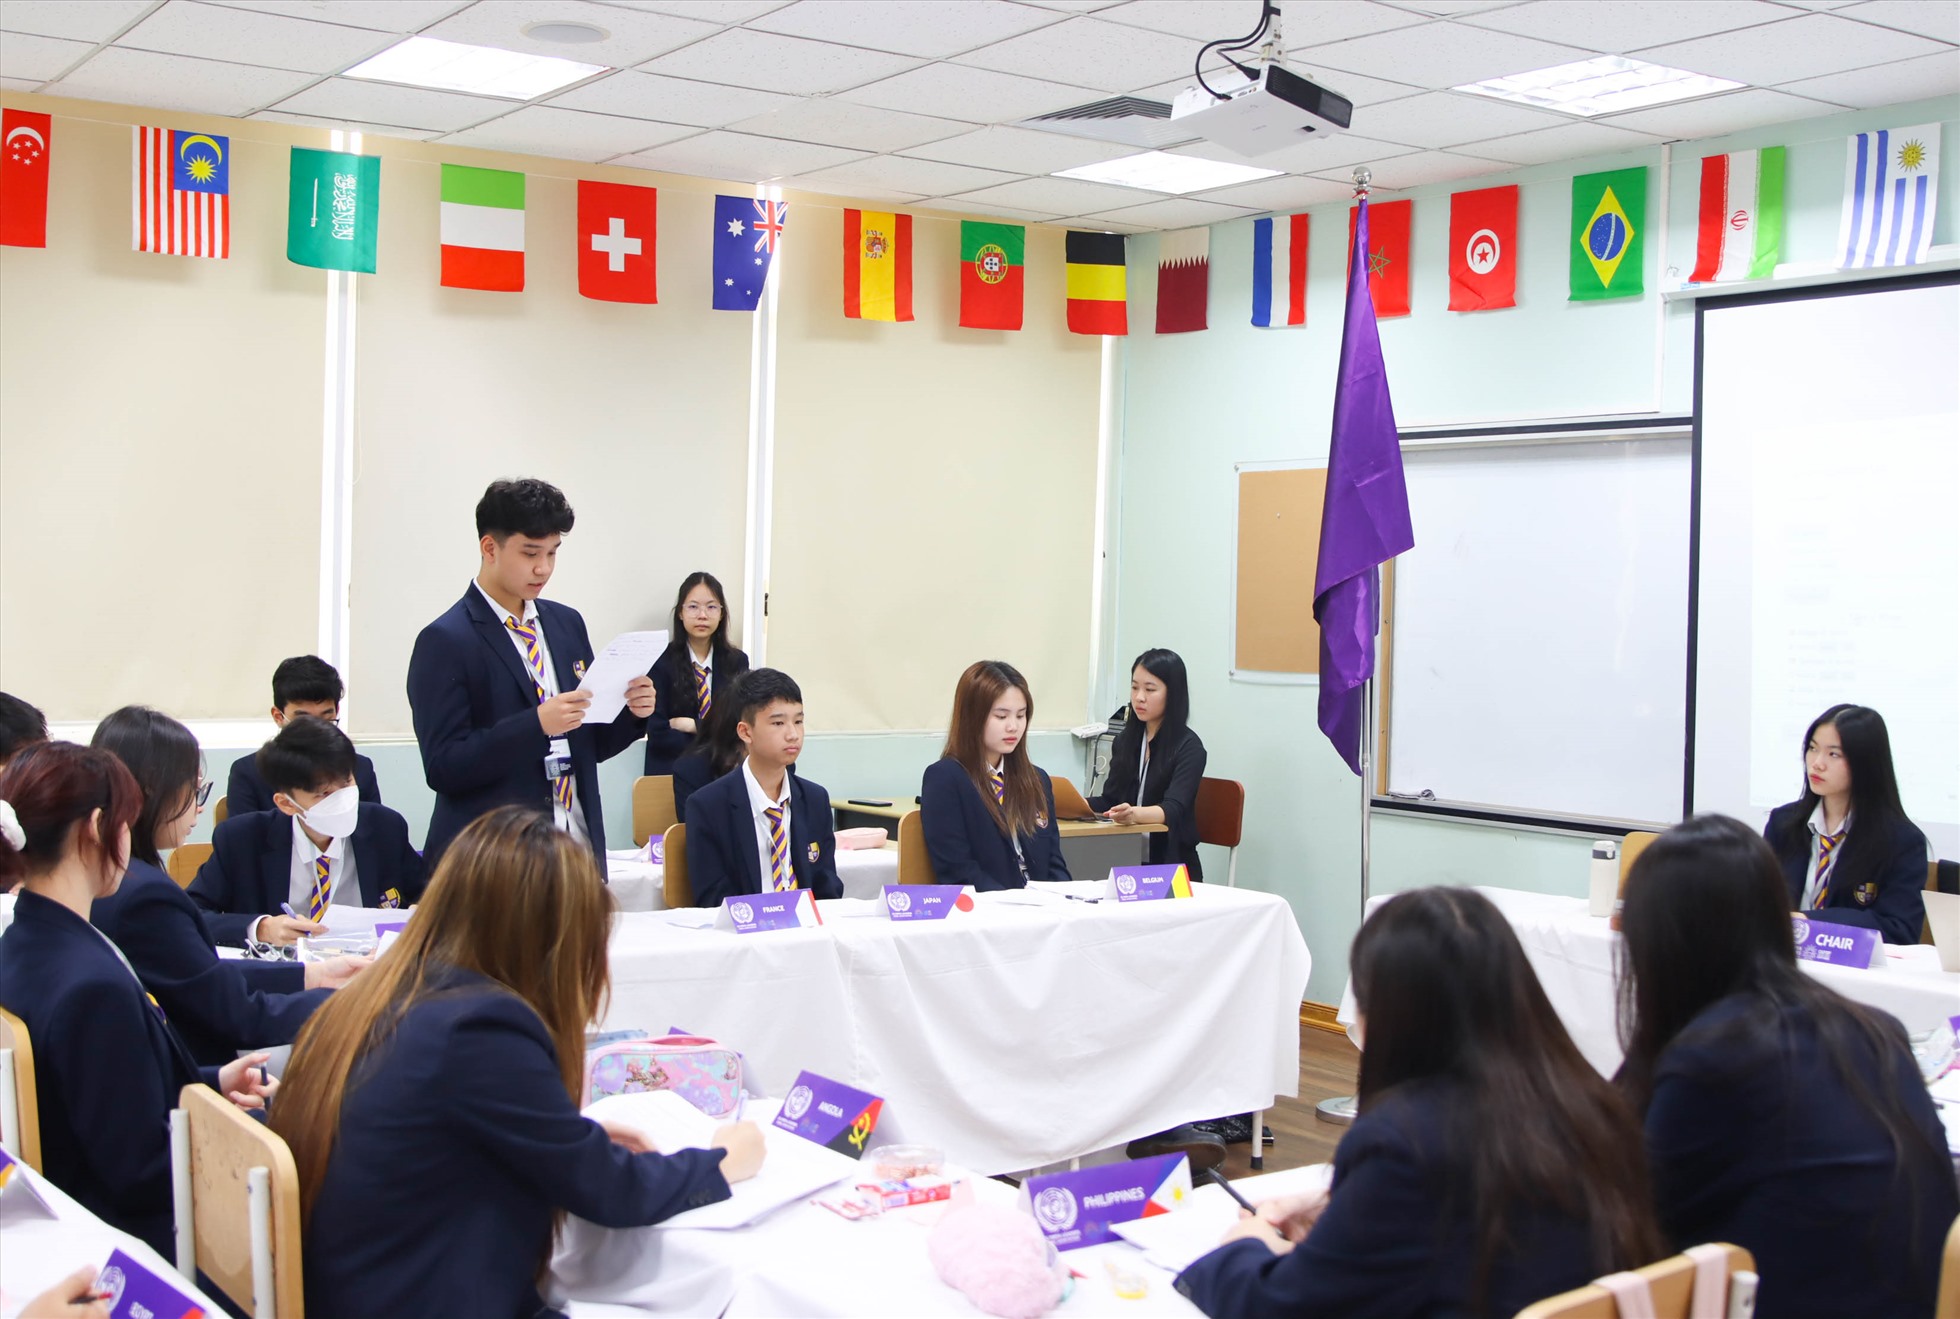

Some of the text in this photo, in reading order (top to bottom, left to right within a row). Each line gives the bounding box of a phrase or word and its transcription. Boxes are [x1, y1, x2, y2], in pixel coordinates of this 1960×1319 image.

[762, 905, 785, 914] FRANCE
[923, 897, 942, 905] JAPAN
[1815, 933, 1854, 951] CHAIR
[817, 1101, 844, 1119] ANGOLA
[1082, 1186, 1146, 1210] PHILIPPINES
